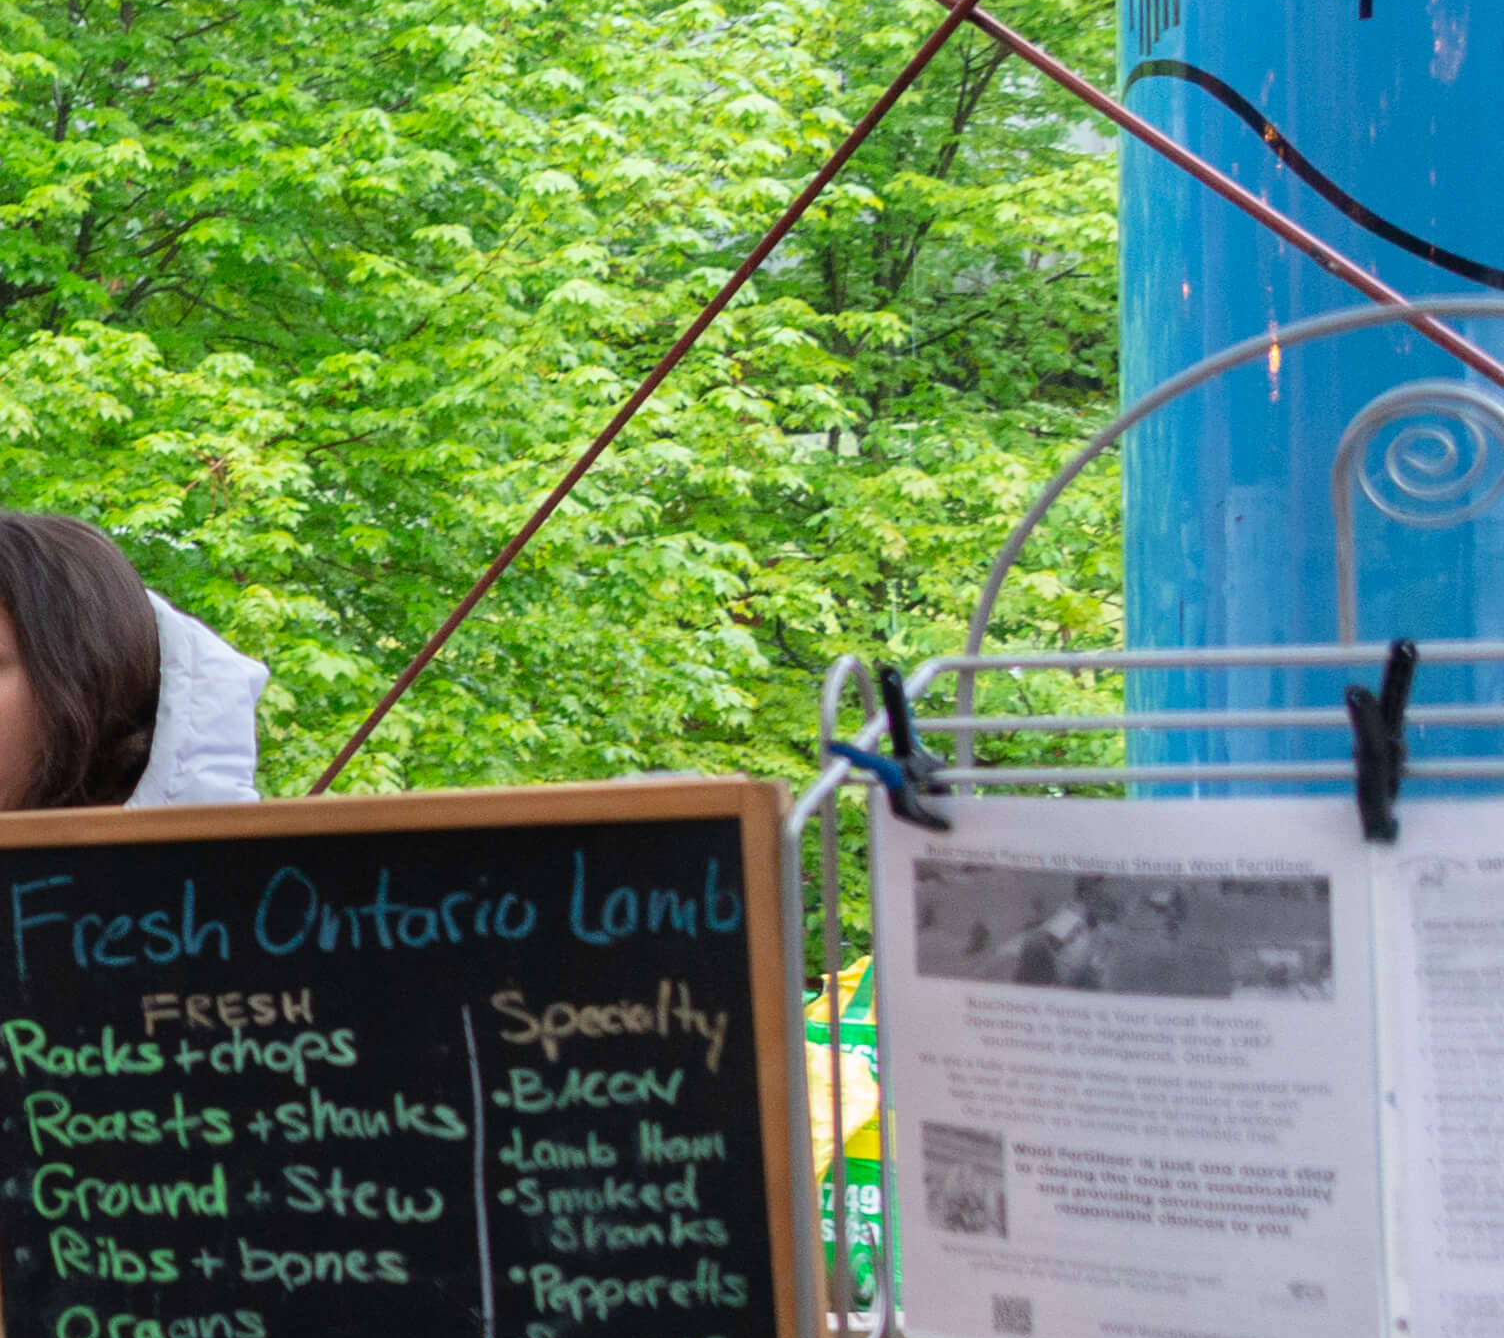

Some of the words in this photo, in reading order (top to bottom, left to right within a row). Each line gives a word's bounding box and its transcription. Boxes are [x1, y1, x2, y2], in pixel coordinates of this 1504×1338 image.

[1132, 857, 1183, 874] Sheep
[1188, 858, 1231, 872] Wool
[12, 874, 229, 981] Fresh
[255, 865, 536, 955] Ontario
[569, 848, 742, 945] Lamb
[141, 988, 314, 1037] FRESH
[490, 977, 728, 1074] Specialty
[963, 1014, 1033, 1034] Operating
[1154, 1014, 1195, 1027] Local
[0, 1019, 163, 1077] Racks
[508, 1067, 684, 1112] BACON
[24, 1090, 234, 1156] Roasts
[511, 1126, 617, 1172] Lamb
[639, 1119, 725, 1164] Ham
[1012, 1143, 1054, 1158] Wool
[1160, 1156, 1194, 1173] just
[1200, 1162, 1233, 1175] one
[1239, 1164, 1287, 1178] more
[1015, 1162, 1031, 1174] to
[1037, 1163, 1095, 1183] closing
[1100, 1169, 1127, 1185] the
[1133, 1172, 1170, 1190] loop
[1177, 1178, 1199, 1190] on
[1206, 1179, 1333, 1204] sustainability
[31, 1163, 228, 1220] Ground
[283, 1165, 443, 1222] Stew
[517, 1163, 699, 1216] Smoked
[1037, 1181, 1066, 1197] and
[1071, 1185, 1153, 1207] providing
[1158, 1194, 1310, 1220] environmentally
[1054, 1202, 1151, 1224] responsible
[1157, 1212, 1225, 1231] choices
[1231, 1219, 1248, 1232] to
[50, 1225, 180, 1282] Ribs
[238, 1237, 409, 1291] bones
